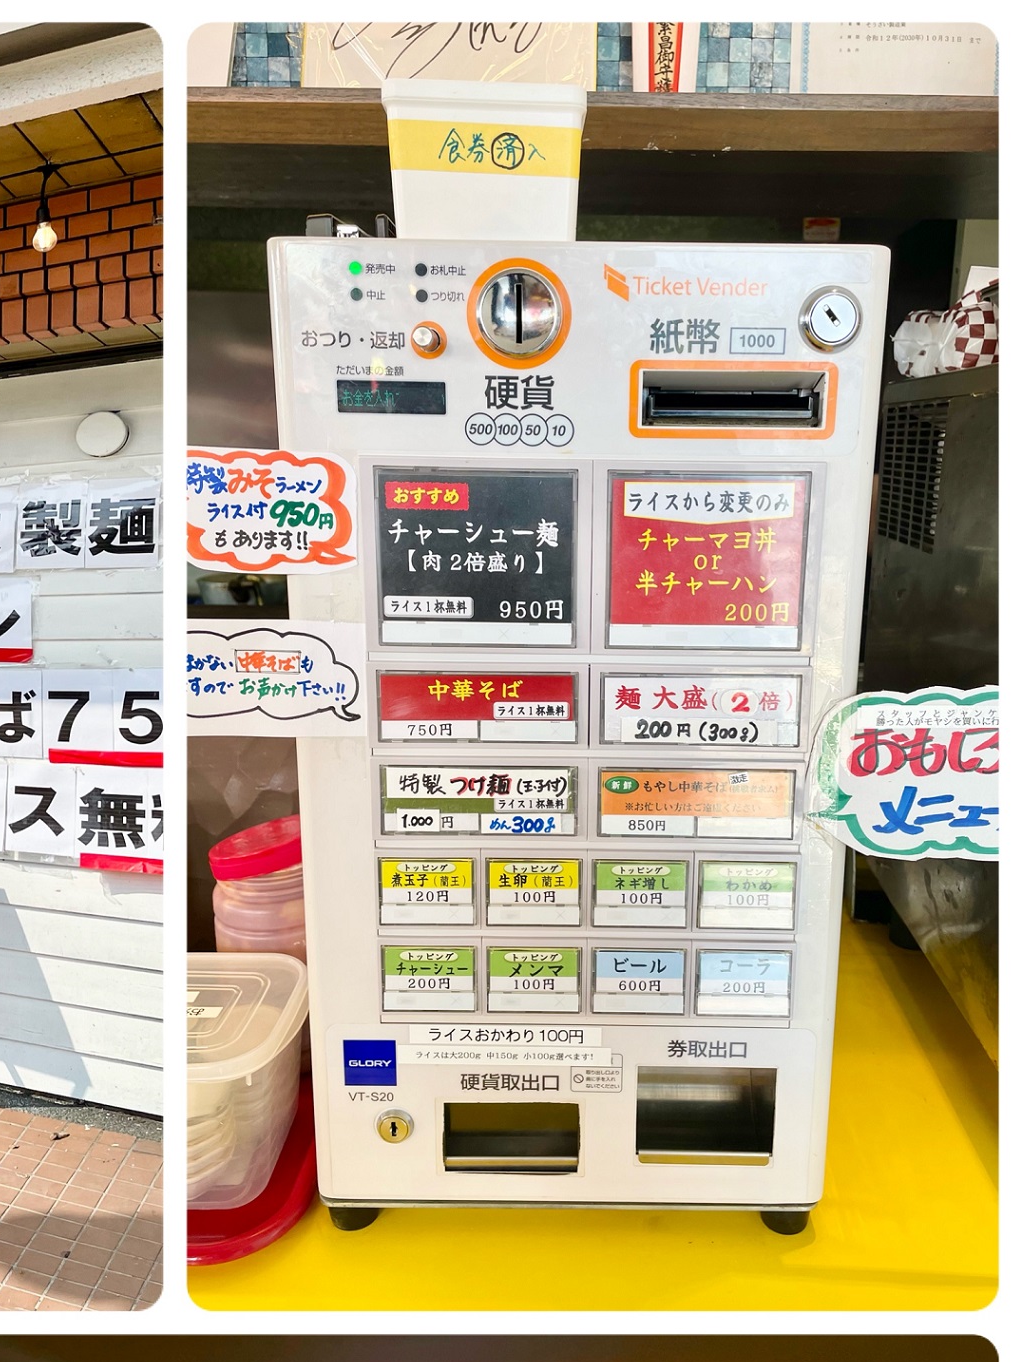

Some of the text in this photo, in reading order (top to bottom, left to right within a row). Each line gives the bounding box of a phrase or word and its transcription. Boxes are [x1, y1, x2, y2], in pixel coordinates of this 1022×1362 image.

[365, 263, 466, 276] 発売中 お札中止
[632, 276, 768, 296] Ticket Vender
[367, 290, 464, 302] 中止 つり切れ
[301, 331, 406, 350] おつり・返却
[650, 318, 776, 354] 紙幣 1000
[336, 365, 404, 376] ただいまの金額
[484, 374, 555, 410] 硬貨
[469, 424, 566, 436] 500 100 50 10
[393, 488, 460, 504] おすすめ
[628, 491, 790, 513] ライスから変更のみ
[388, 518, 559, 548] チャーシュー麺
[638, 527, 777, 553] チャーマヨ丼
[694, 554, 722, 570] or
[635, 570, 777, 596] 半チャーハン
[390, 600, 564, 619] ライス1杯無料 950円
[725, 603, 790, 622] 200円
[428, 679, 523, 701] 中華そば
[497, 705, 565, 716] ライス1杯無料
[407, 724, 452, 736] 750円
[611, 781, 632, 790] 新鮮
[628, 820, 666, 831] 850円
[619, 866, 663, 874] トッピング
[726, 868, 773, 876] トッピング
[614, 877, 670, 890] ネギ増し
[726, 880, 773, 891] わかめ
[406, 890, 449, 902] 120円
[514, 891, 556, 903] 100円
[621, 893, 662, 904] 100円
[728, 894, 769, 905] 100円
[407, 952, 454, 960] トッピング
[512, 953, 559, 961] トッピング
[396, 962, 468, 976] チャーシュー
[509, 964, 564, 977] メンマ
[614, 958, 667, 974] ビール
[720, 959, 771, 976] コーラ
[408, 978, 450, 989] 200円
[514, 979, 555, 990] 100円
[619, 980, 661, 992] 600円
[723, 982, 766, 994] 200円
[428, 1028, 584, 1044] ライスおかわり100円
[460, 1040, 748, 1092] 硬貨取出口 券取出口
[348, 1092, 394, 1102] VT-S20
